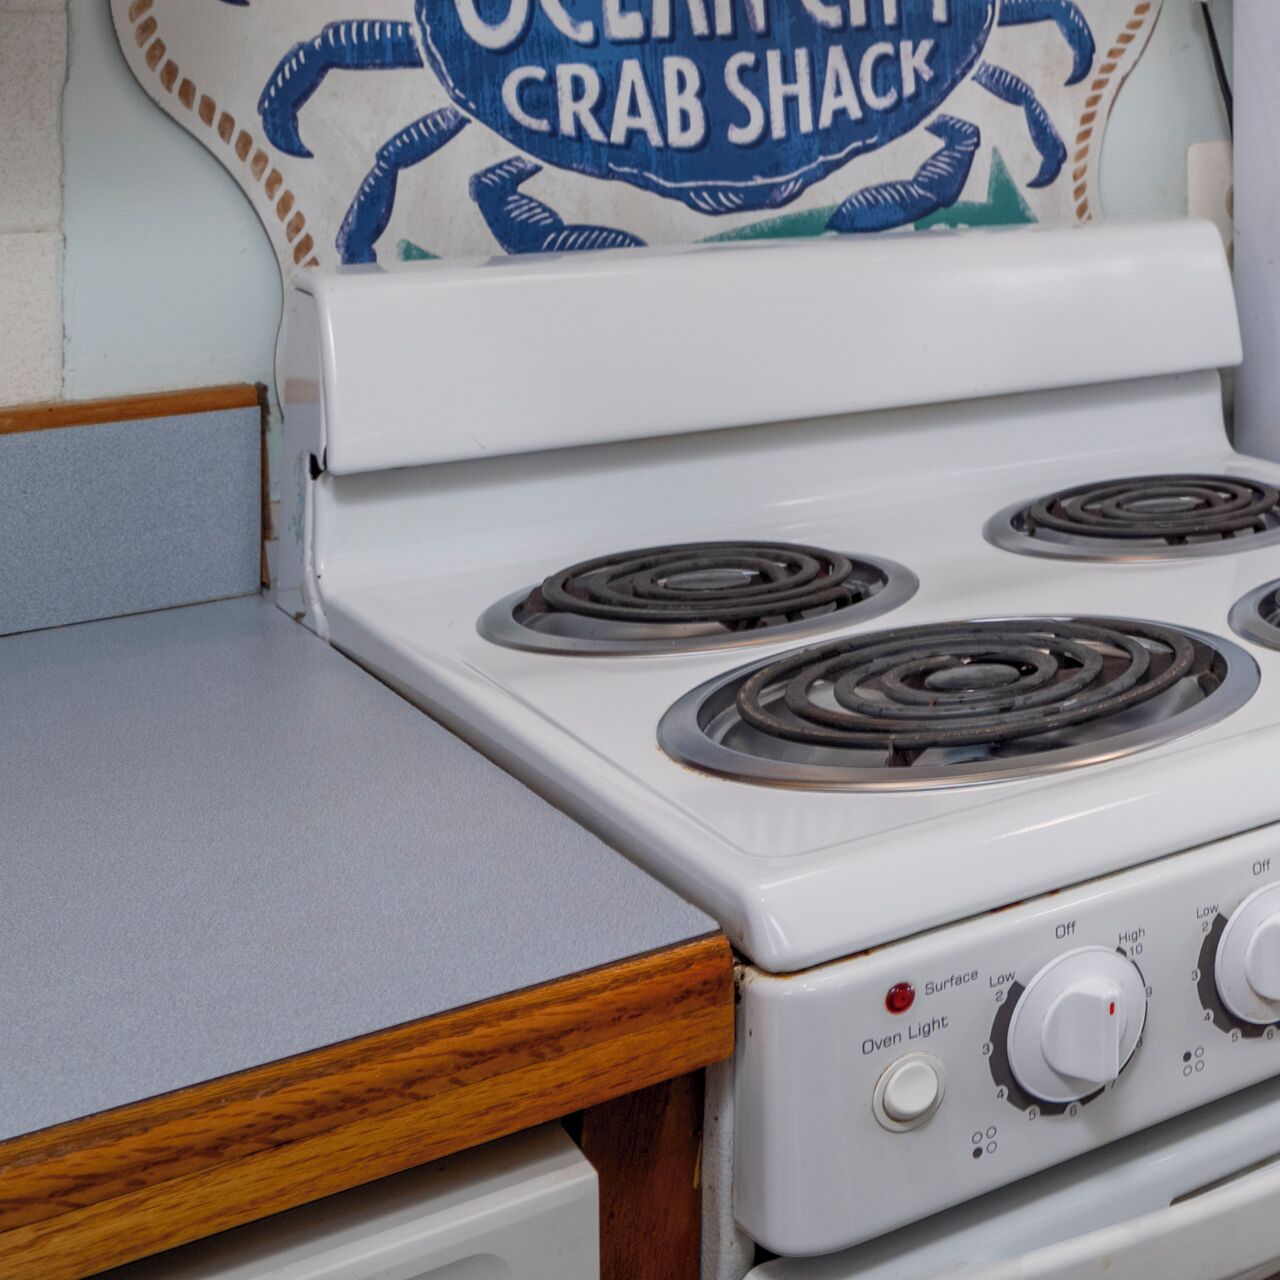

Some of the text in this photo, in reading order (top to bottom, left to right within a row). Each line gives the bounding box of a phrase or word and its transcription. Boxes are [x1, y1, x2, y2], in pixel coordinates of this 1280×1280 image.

[501, 38, 936, 150] CRAB SHACK
[1252, 858, 1271, 876] Off
[1196, 904, 1220, 919] Low
[1055, 920, 1077, 940] Off
[1201, 921, 1209, 932] 2
[1118, 927, 1146, 946] High
[1129, 943, 1144, 957] 10
[925, 969, 979, 997] Surface
[989, 971, 1016, 988] Low
[1191, 971, 1199, 983] 3
[995, 991, 1004, 1003] 2
[1145, 987, 1153, 999] 9
[1204, 1012, 1211, 1022] 4
[862, 1015, 950, 1056] Oven Light
[1232, 1032, 1239, 1043] 5
[1267, 1029, 1274, 1040] 6
[982, 1043, 992, 1056] 3
[996, 1088, 1005, 1100] 4
[1028, 1110, 1037, 1122] 5
[1069, 1105, 1078, 1117] 6
